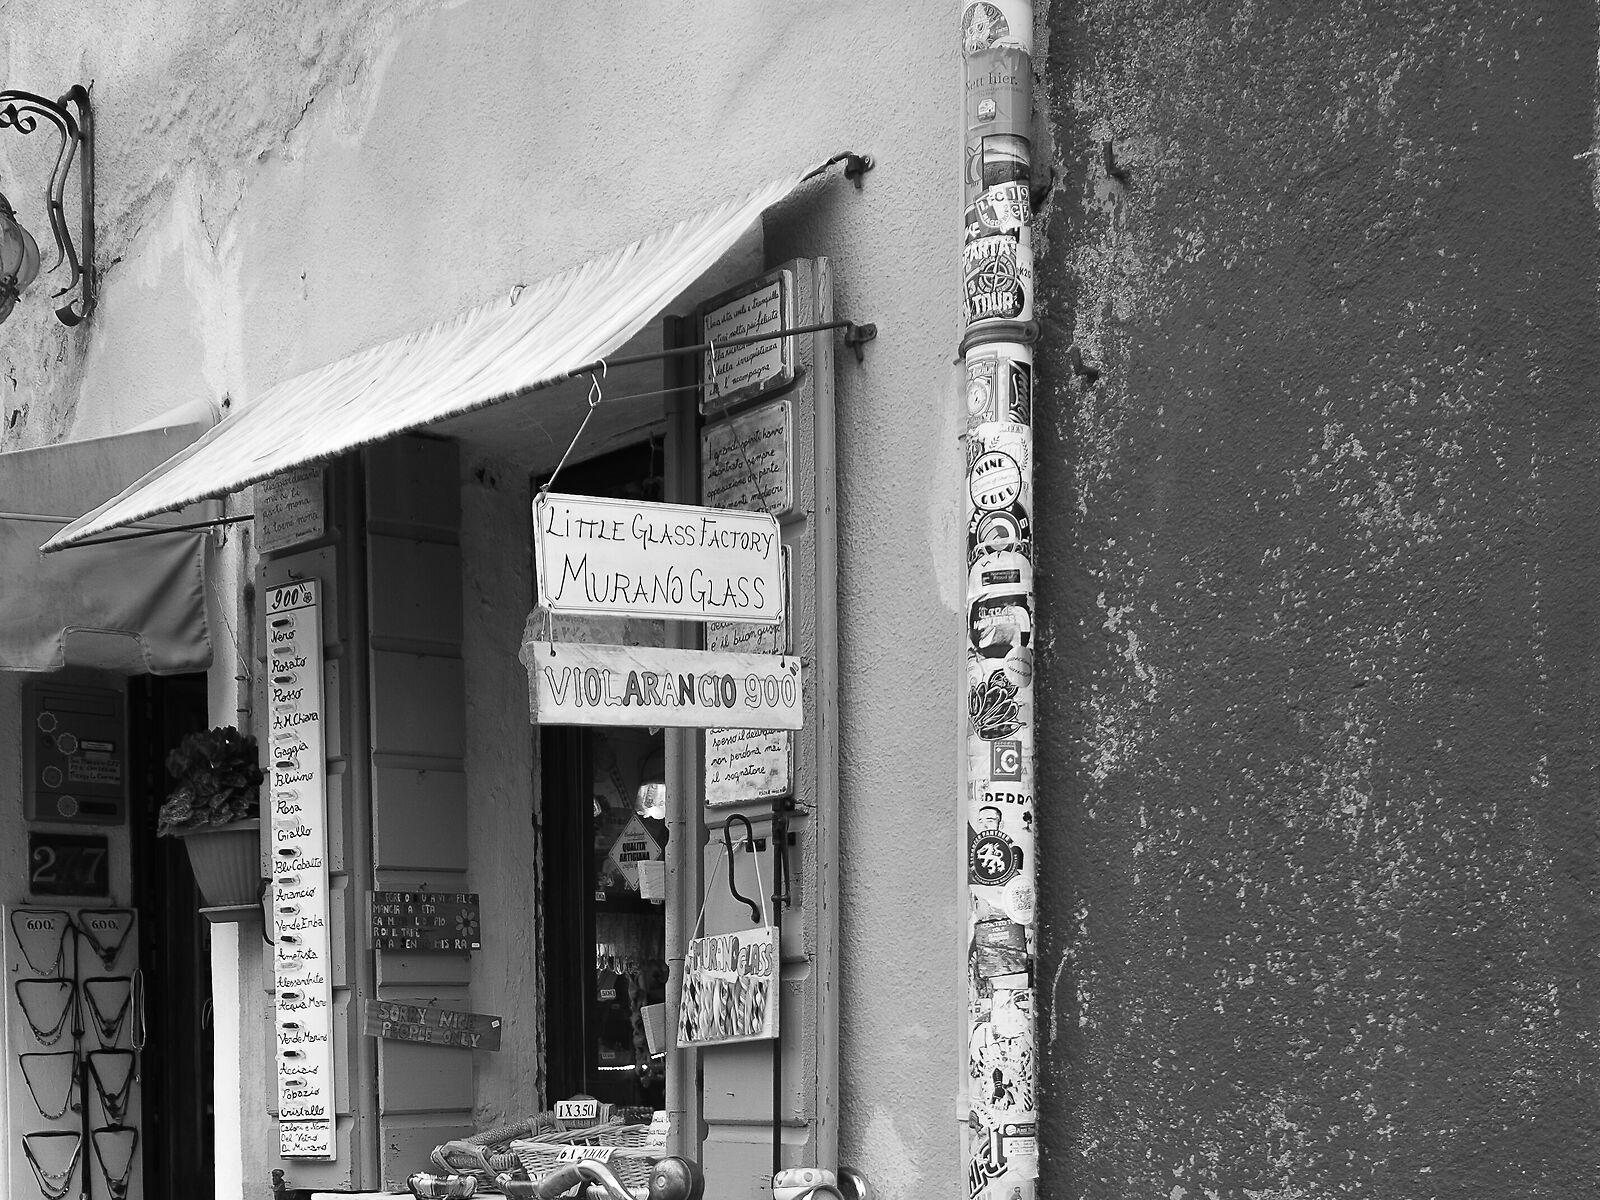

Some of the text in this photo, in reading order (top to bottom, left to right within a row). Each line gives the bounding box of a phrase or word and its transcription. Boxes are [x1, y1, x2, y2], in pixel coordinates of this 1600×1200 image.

[747, 449, 776, 466] sempre
[975, 457, 1006, 476] WINE
[631, 512, 697, 551] GLASS
[700, 516, 775, 560] FACTORY
[554, 552, 766, 611] MURANO GLASS
[271, 629, 297, 643] Nero
[272, 655, 308, 673] Rosato
[272, 687, 304, 703] Rosso
[544, 665, 737, 709] VIOLARANCIO
[274, 740, 309, 761] Gaggia
[710, 741, 781, 769] non perdona mai
[275, 771, 315, 787] Bluino
[711, 764, 766, 785] il sognatore
[276, 800, 303, 815] Rosa
[277, 824, 313, 842] Giallo
[275, 886, 317, 902] Arancio
[275, 917, 301, 932] Verde
[692, 935, 740, 973] MURANO
[737, 942, 774, 977] GLASS
[377, 1002, 427, 1026] SORRY
[277, 1032, 303, 1045] Verde
[381, 1021, 481, 1049] PEOPLE ONLY
[280, 1133, 293, 1143] Del
[292, 1141, 329, 1152] Murano
